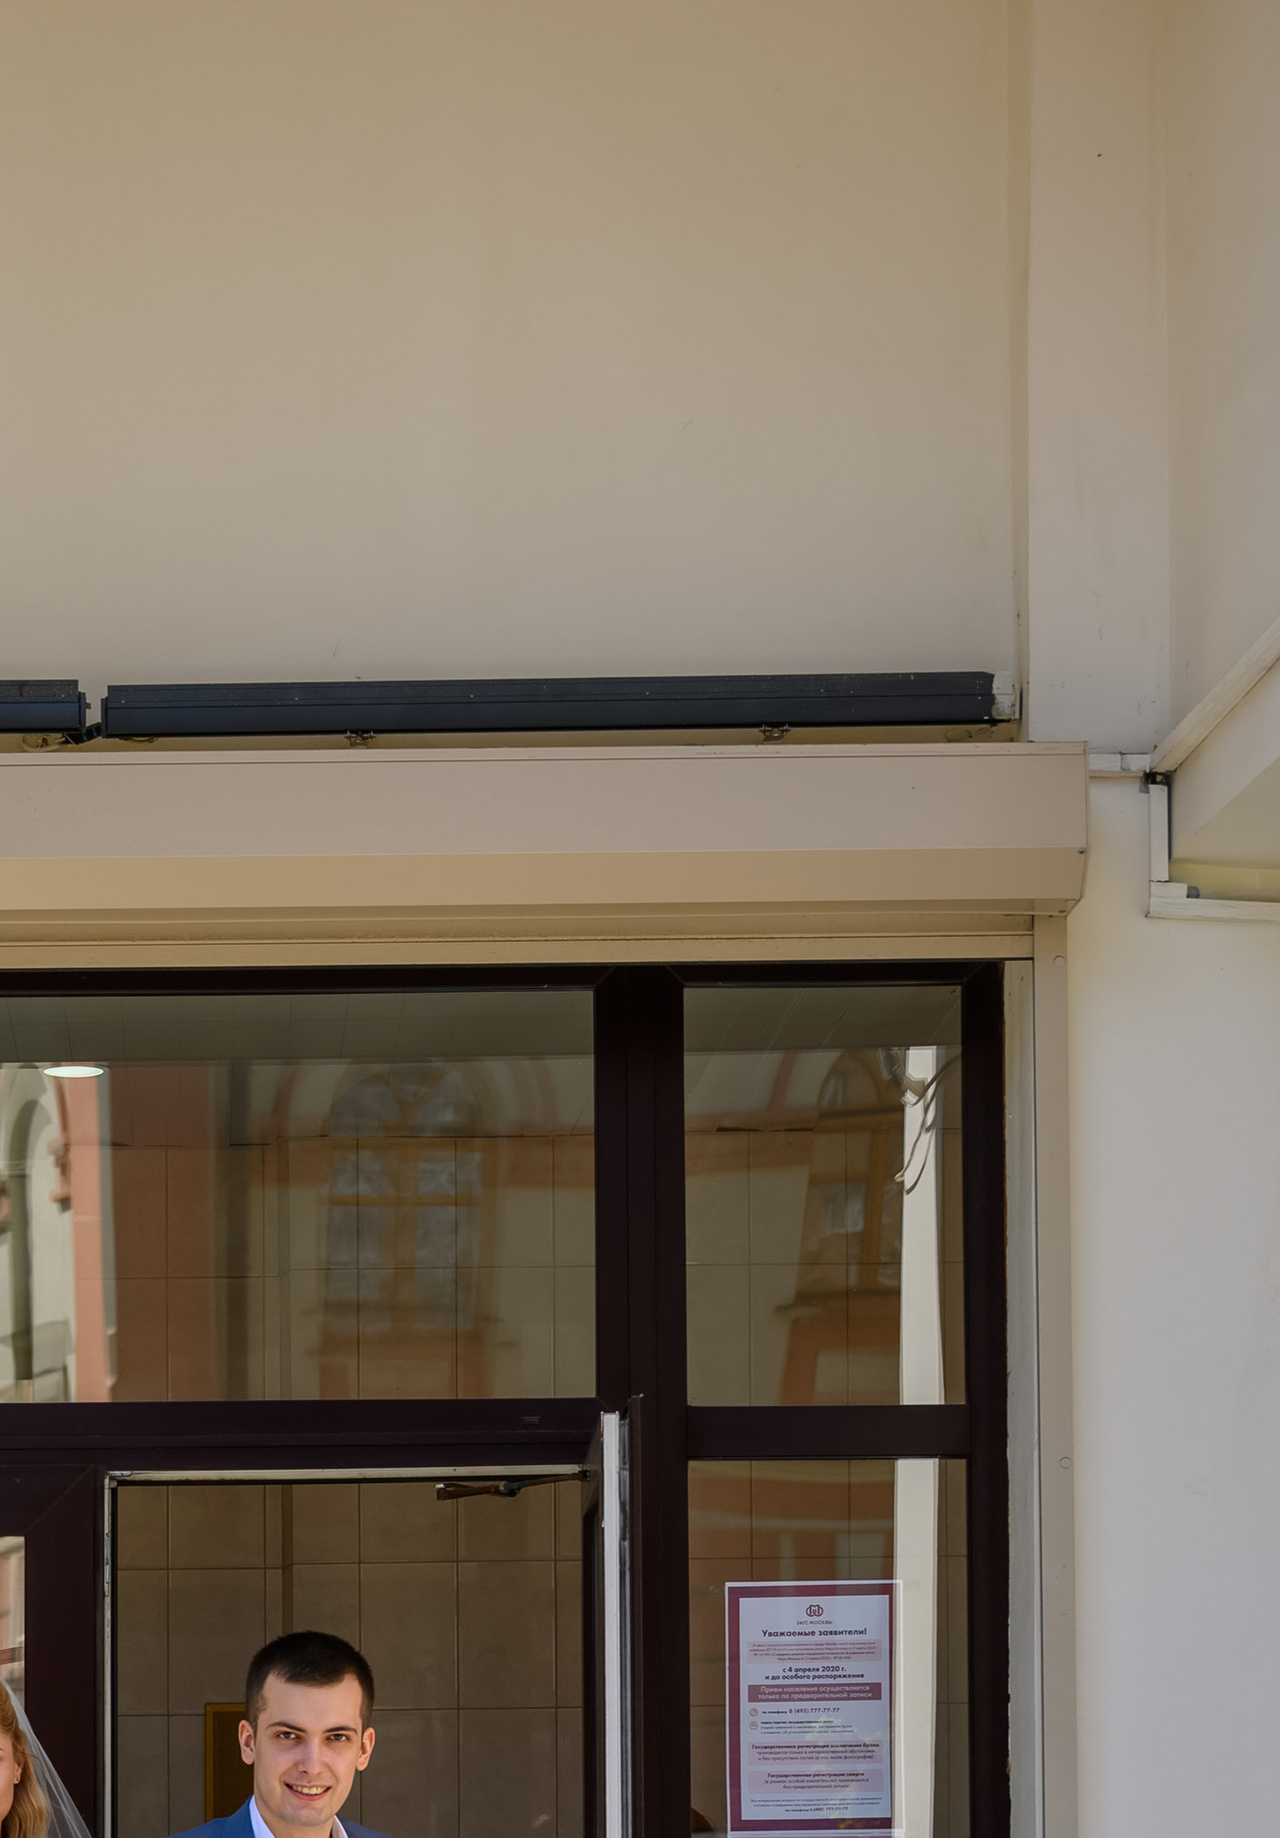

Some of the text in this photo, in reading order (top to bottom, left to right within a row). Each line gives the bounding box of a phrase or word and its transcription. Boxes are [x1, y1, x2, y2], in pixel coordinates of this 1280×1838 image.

[818, 1628, 867, 1636] заявители!
[812, 1673, 864, 1681] распоряжения
[791, 1692, 847, 1700] предварительной
